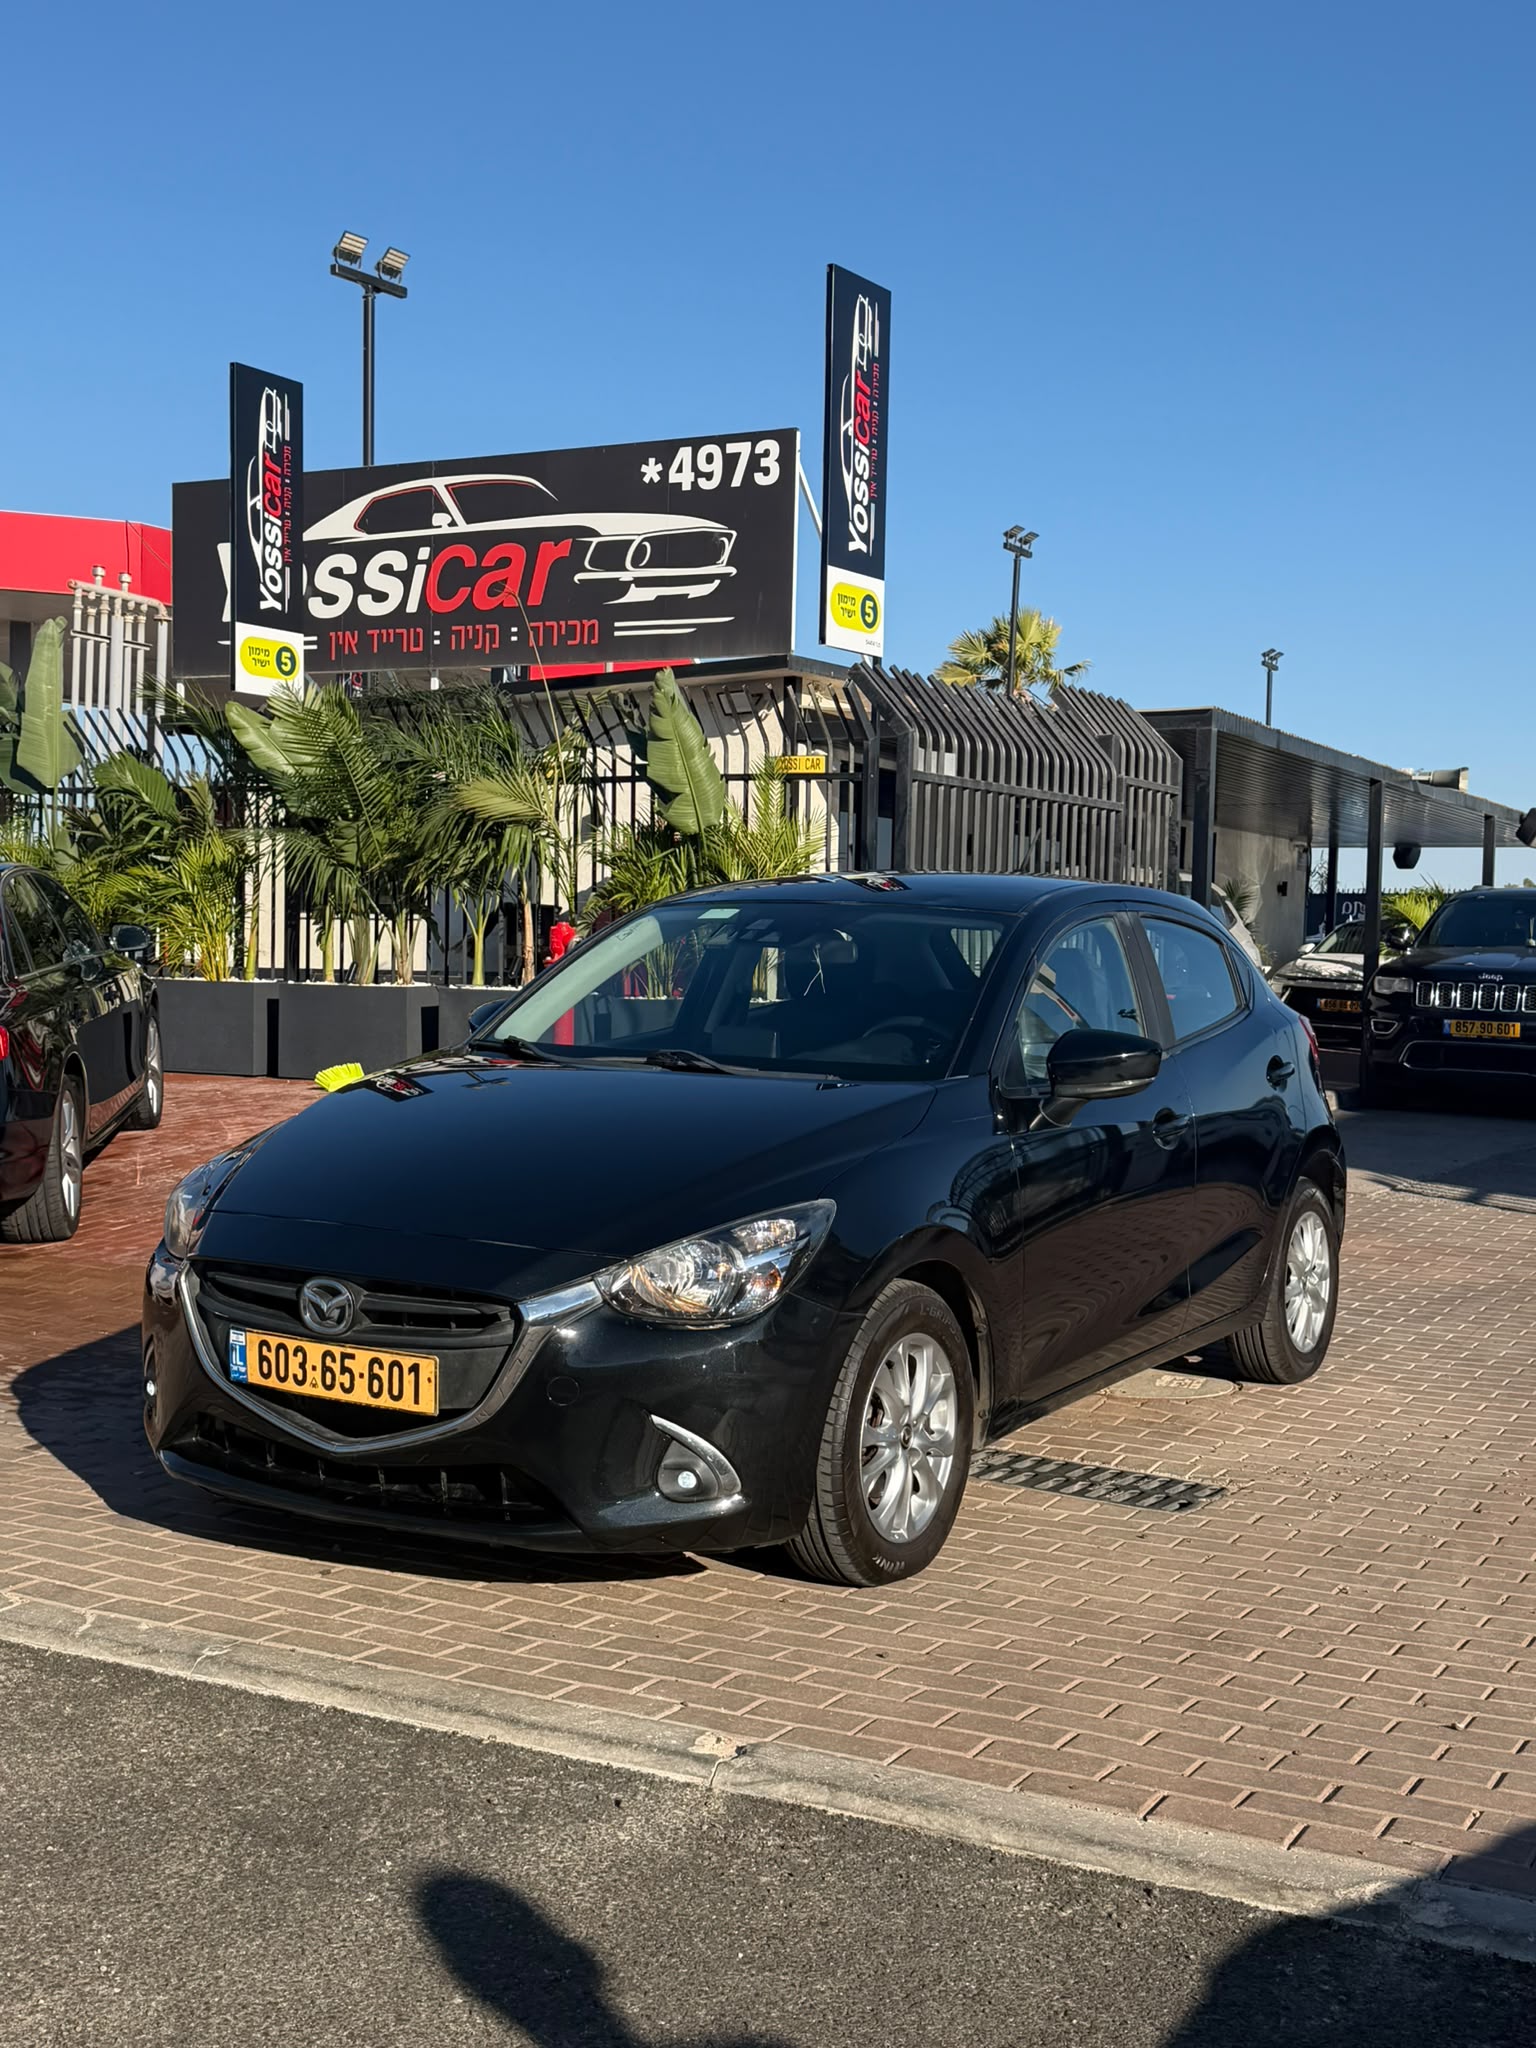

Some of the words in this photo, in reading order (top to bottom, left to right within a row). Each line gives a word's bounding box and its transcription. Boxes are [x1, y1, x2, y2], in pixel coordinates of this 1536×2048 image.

[217, 538, 573, 622] ssicar
[864, 599, 874, 624] 5
[329, 630, 359, 661] אין
[366, 627, 424, 654] טרייד
[451, 624, 500, 655] קניה
[528, 618, 599, 648] מכירה
[248, 645, 271, 658] מימון
[252, 657, 271, 668] ישיר
[280, 651, 292, 672] 5
[805, 758, 821, 770] CAR
